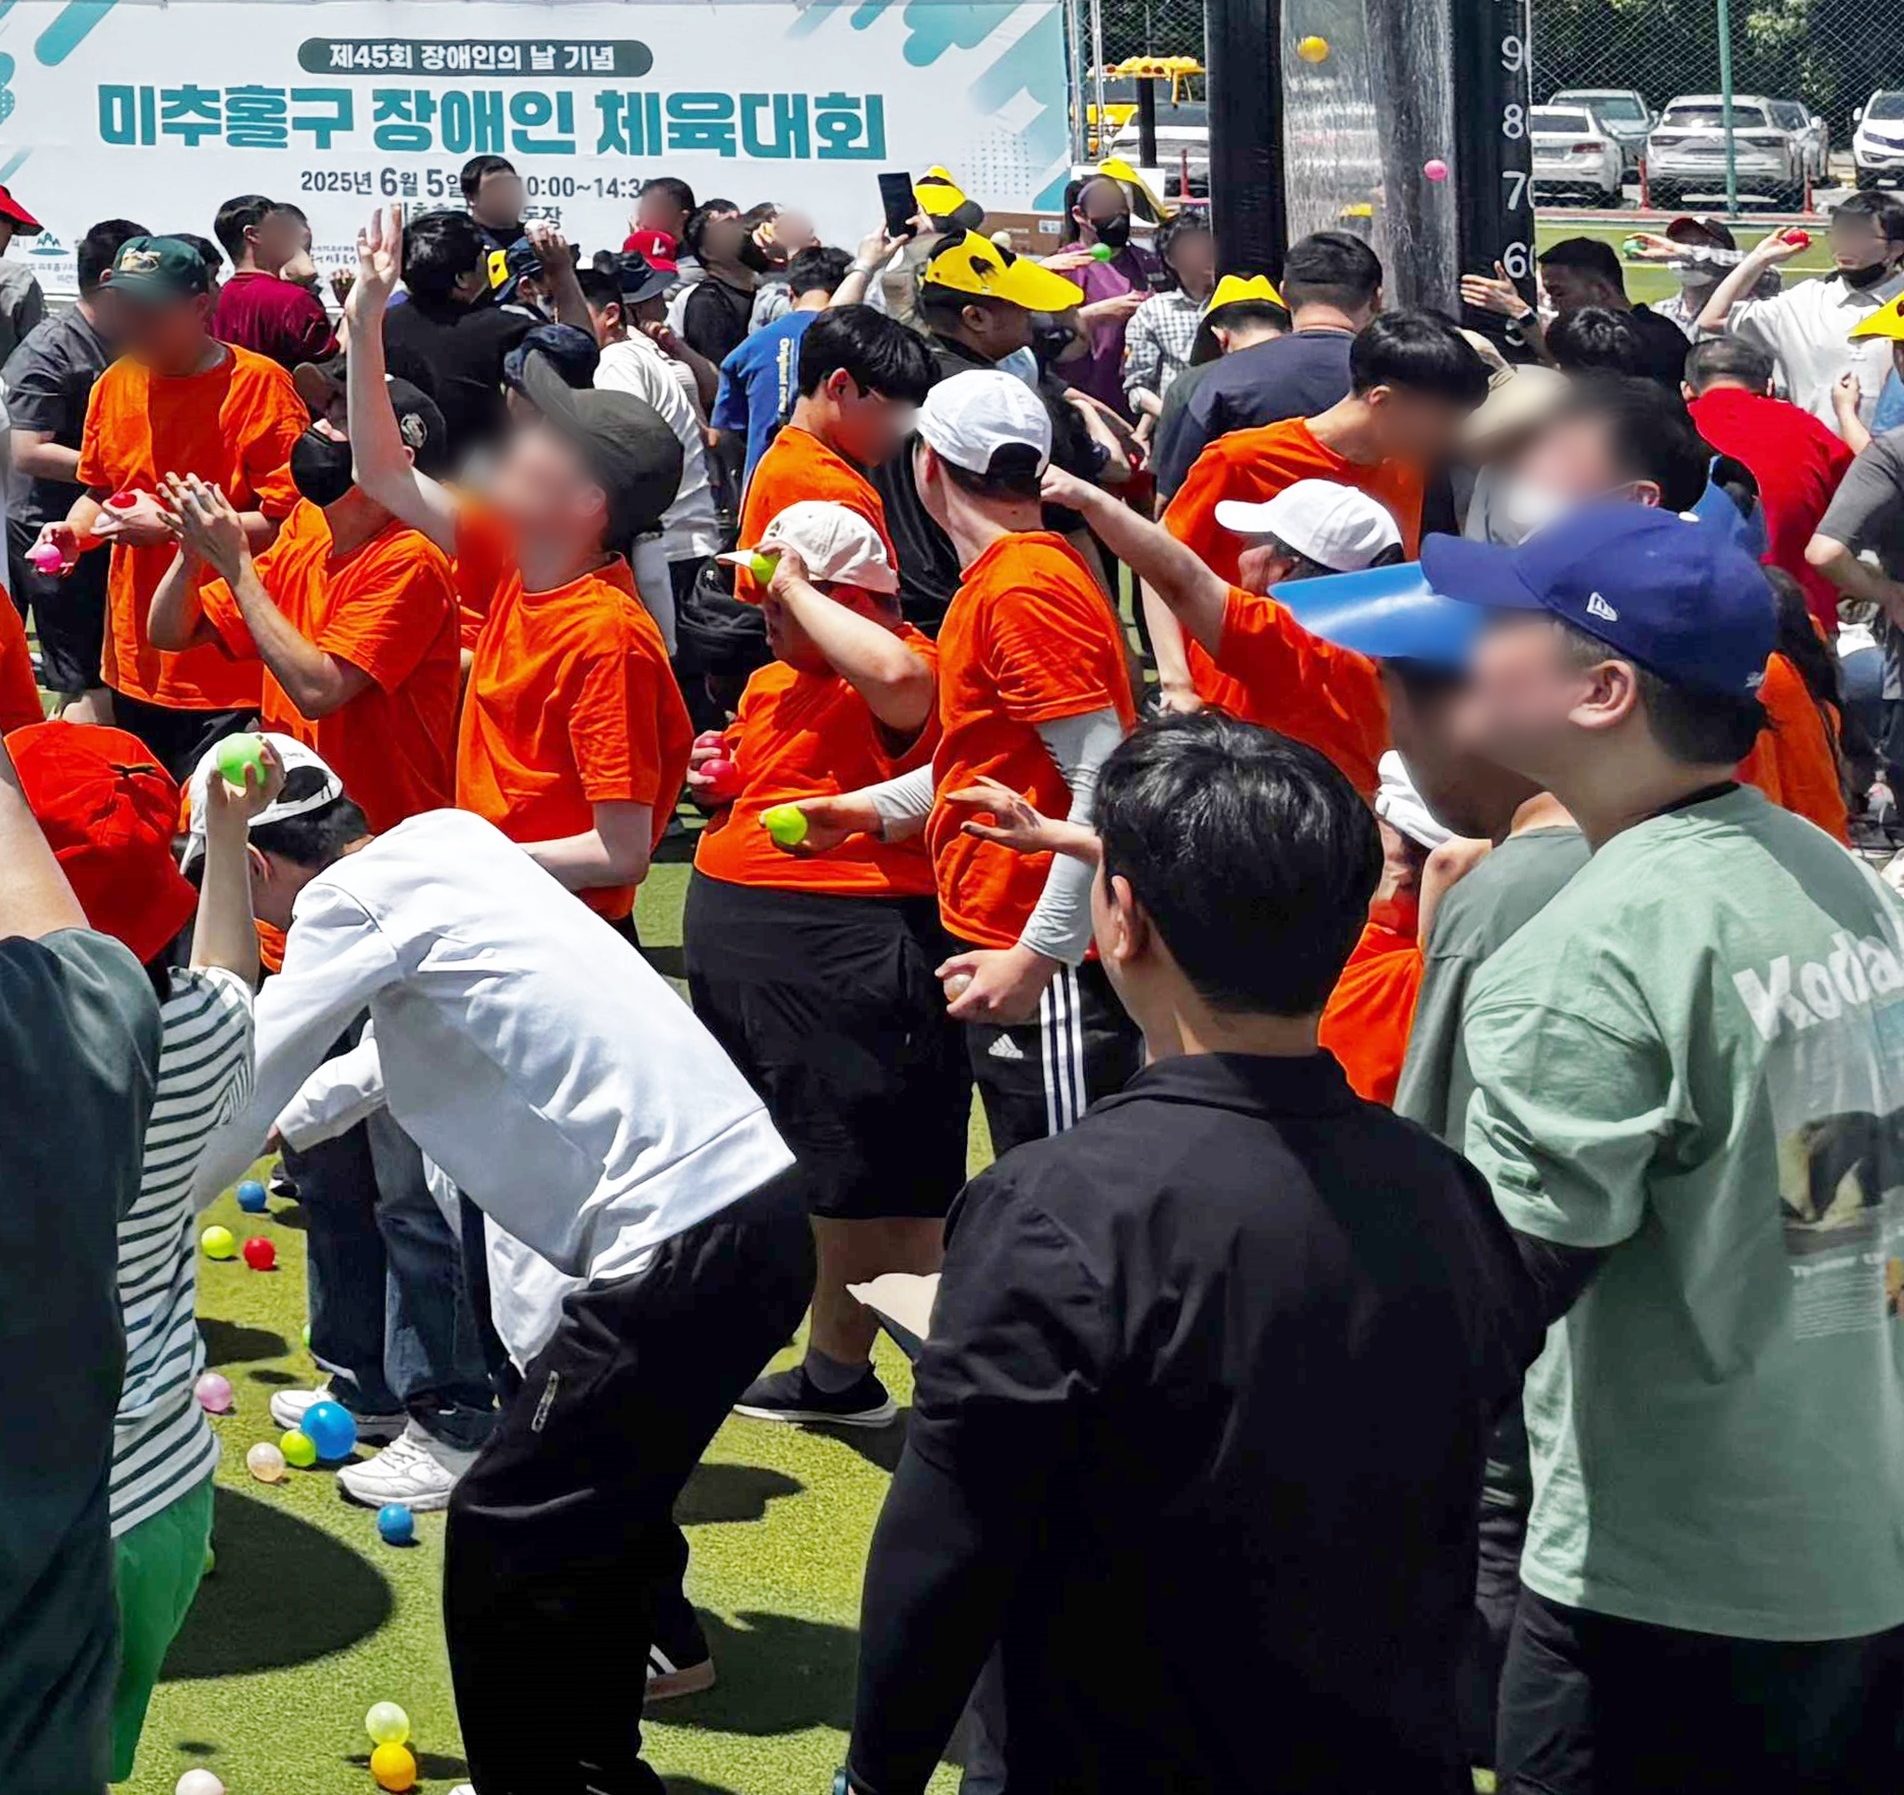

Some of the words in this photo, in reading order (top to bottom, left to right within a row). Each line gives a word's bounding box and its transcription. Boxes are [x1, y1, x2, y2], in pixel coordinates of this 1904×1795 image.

[329, 44, 412, 70] 제45회
[421, 45, 521, 71] 장애인의
[530, 45, 556, 71] 날
[564, 45, 616, 71] 기념
[98, 84, 353, 150] 미추홀구
[372, 88, 576, 156] 장애인
[596, 91, 887, 161] 체육대회
[301, 170, 372, 195] 2025년
[379, 168, 419, 197] 6월
[526, 176, 650, 199] 0:00~14:3
